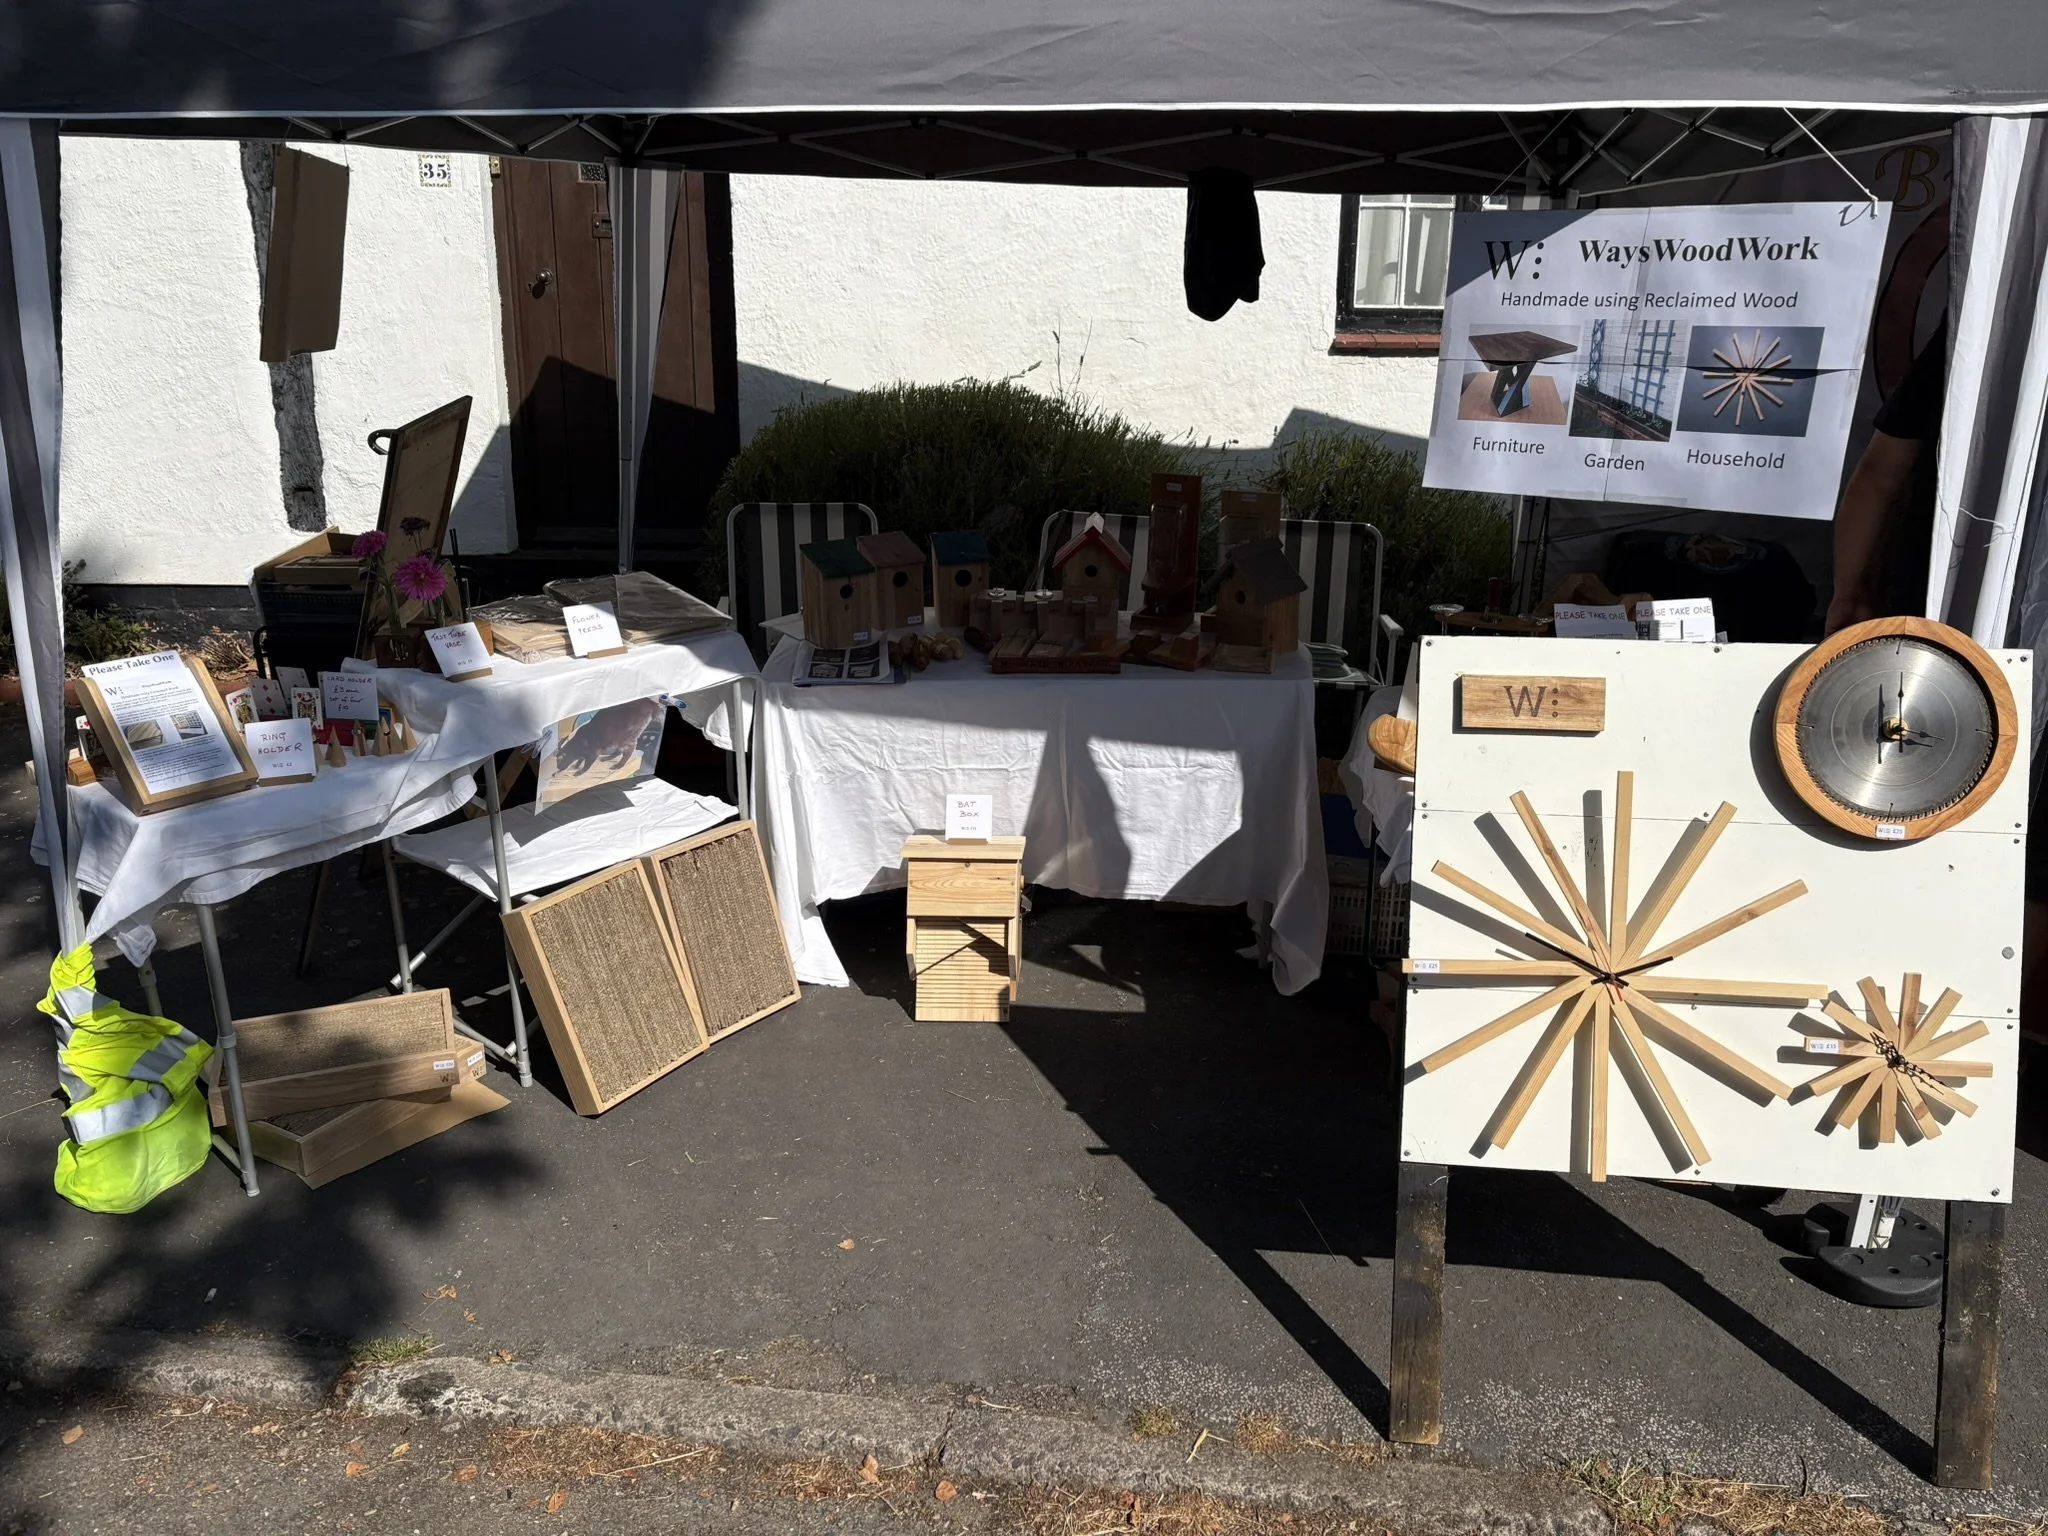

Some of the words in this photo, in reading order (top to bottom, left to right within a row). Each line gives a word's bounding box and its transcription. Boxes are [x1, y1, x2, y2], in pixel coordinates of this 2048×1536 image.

[423, 163, 448, 179] 35
[1579, 236, 1821, 269] WaysWoodWork
[1501, 291, 1589, 307] Handmade
[1594, 291, 1640, 311] using
[1644, 292, 1737, 308] Reclaimed
[1743, 292, 1799, 308] Wood
[1472, 437, 1545, 455] Furniture
[1584, 453, 1645, 471] Garden
[1686, 448, 1785, 469] Household
[572, 613, 601, 625] FLOWER
[1555, 610, 1586, 620] PLEASE
[1588, 611, 1609, 619] TAKE
[1609, 612, 1626, 620] ONE
[1637, 607, 1666, 618] PLEASE
[1669, 606, 1690, 616] TAKE
[1693, 605, 1712, 614] ONE
[88, 665, 123, 675] Please
[124, 659, 151, 668] Take
[152, 654, 175, 663] One
[260, 732, 286, 742] RING
[258, 742, 303, 755] HOLDER
